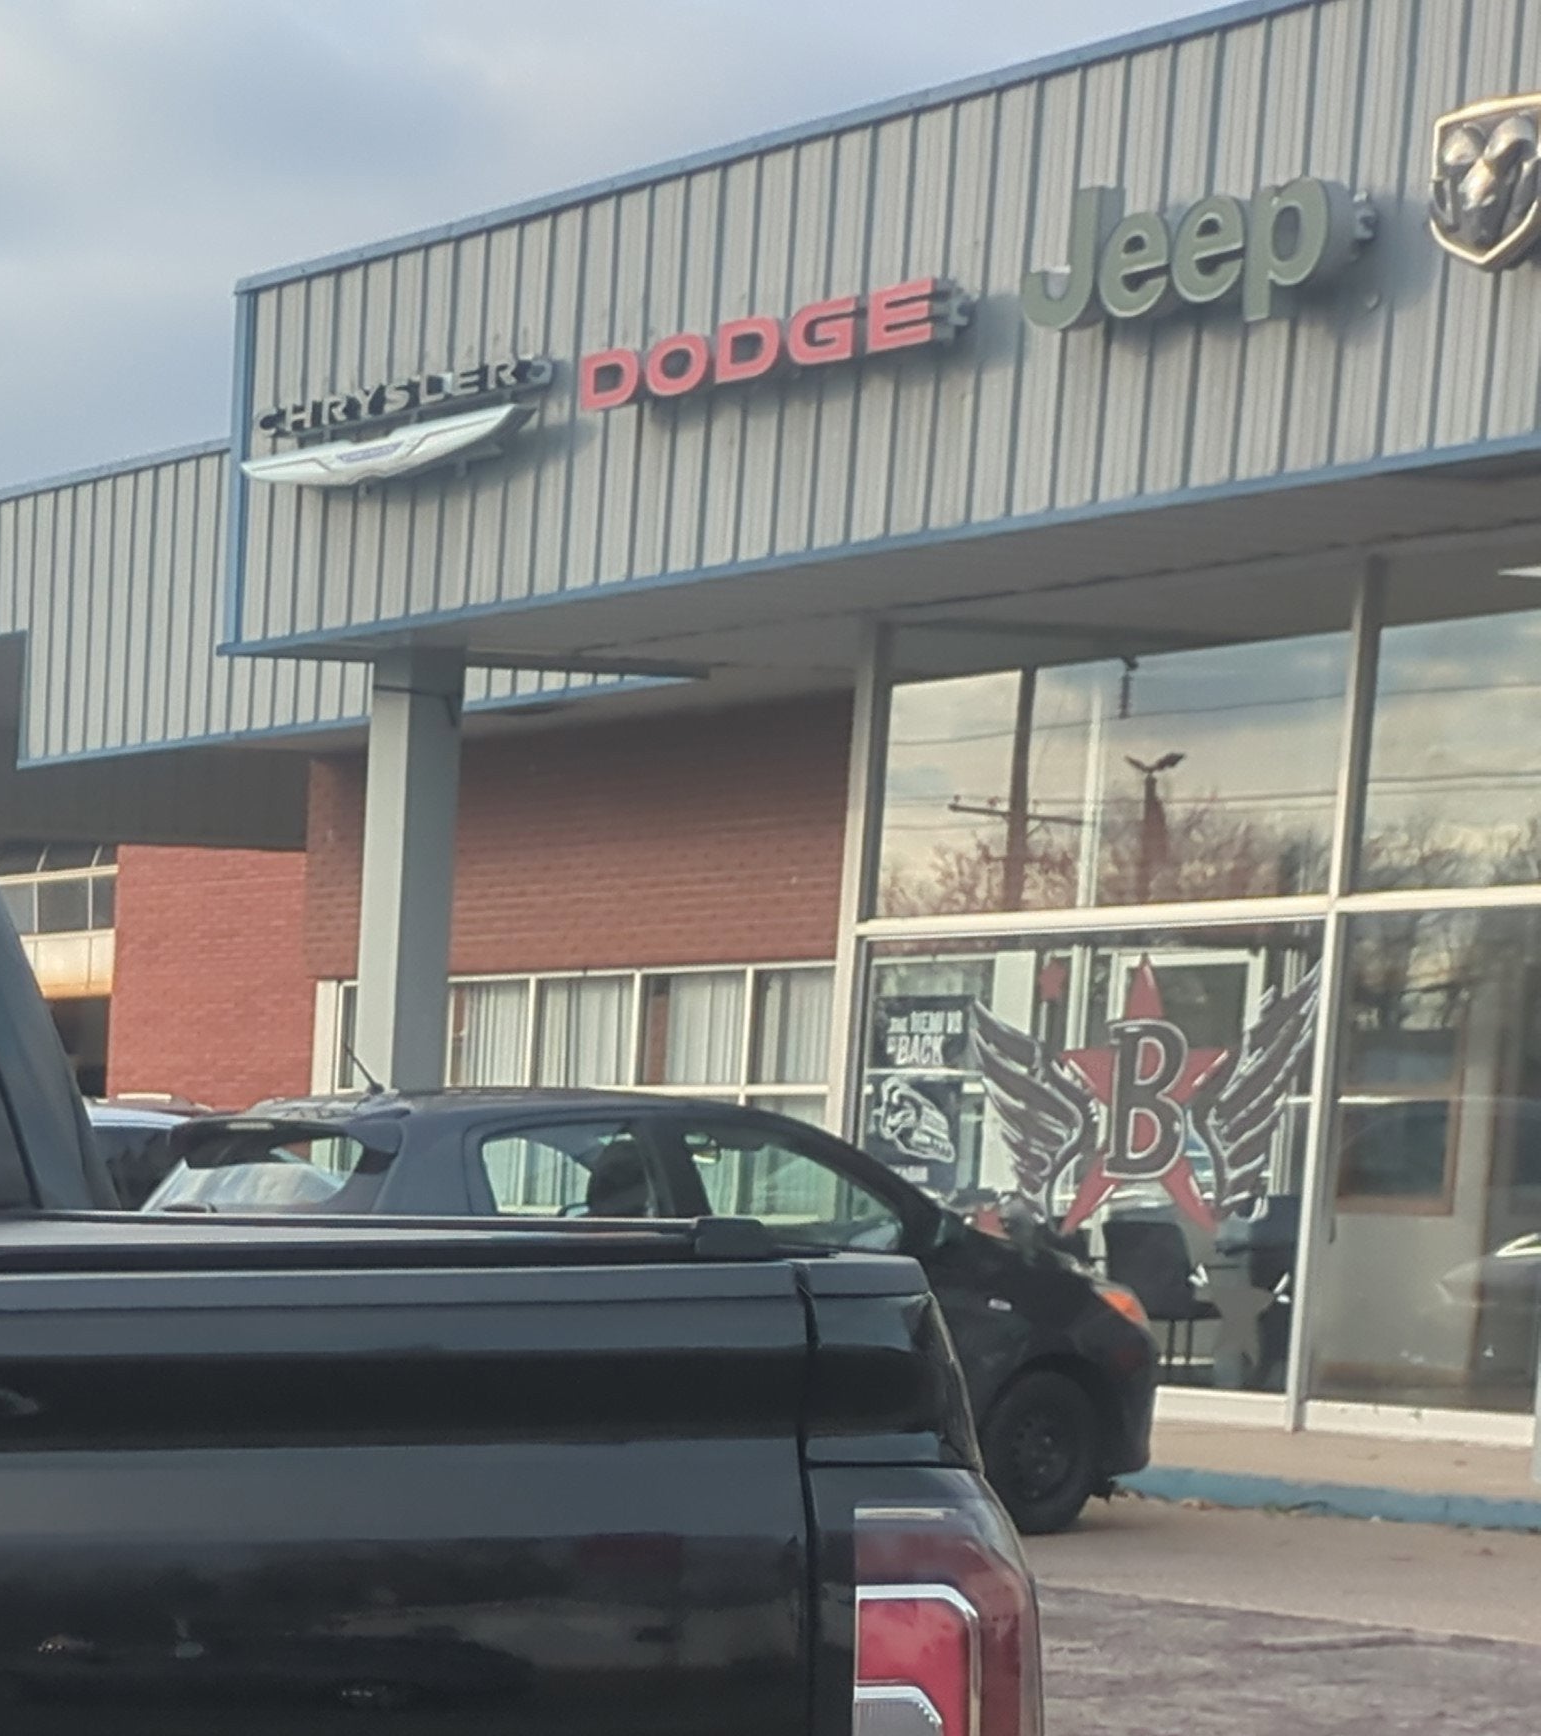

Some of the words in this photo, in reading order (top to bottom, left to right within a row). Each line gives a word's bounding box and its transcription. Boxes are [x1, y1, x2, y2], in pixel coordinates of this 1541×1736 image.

[1021, 177, 1328, 330] Jeep
[255, 358, 529, 438] CHRYSLER
[580, 276, 935, 411] DODGE
[896, 1034, 945, 1065] BACK
[1105, 1020, 1188, 1178] B
